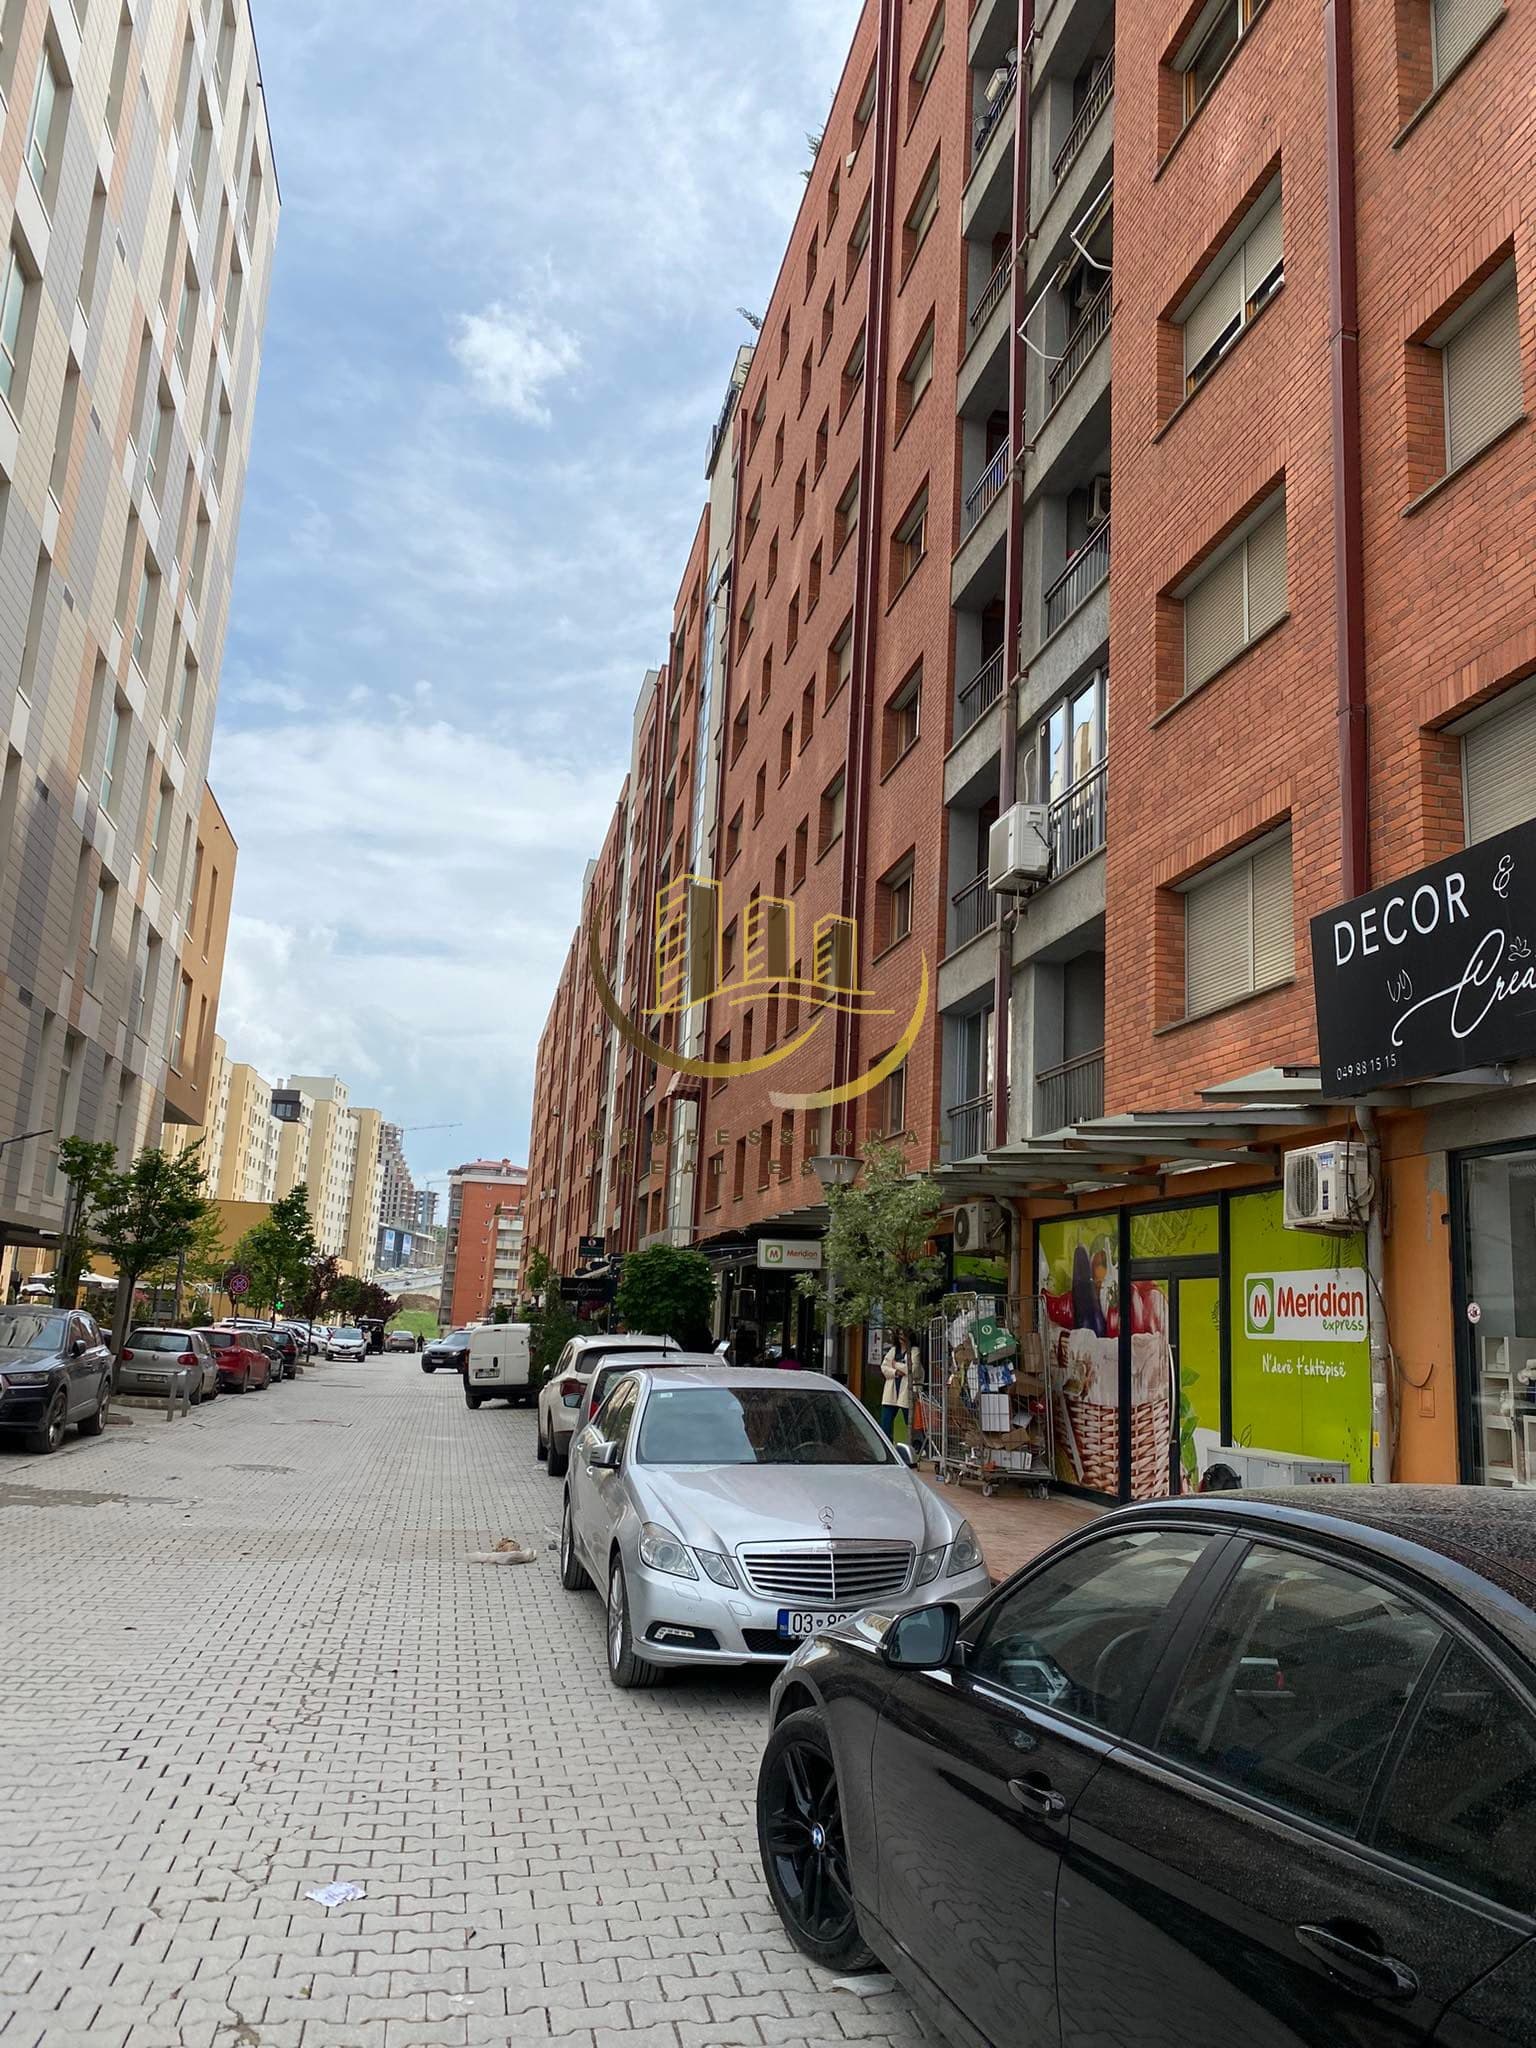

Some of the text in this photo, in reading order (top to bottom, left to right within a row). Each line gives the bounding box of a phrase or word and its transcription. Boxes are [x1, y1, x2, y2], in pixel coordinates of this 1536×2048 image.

[1334, 854, 1515, 967] DECOR &
[1254, 1282, 1365, 1318] M Meridian
[1321, 1319, 1365, 1335] express
[792, 1613, 813, 1633] 03
